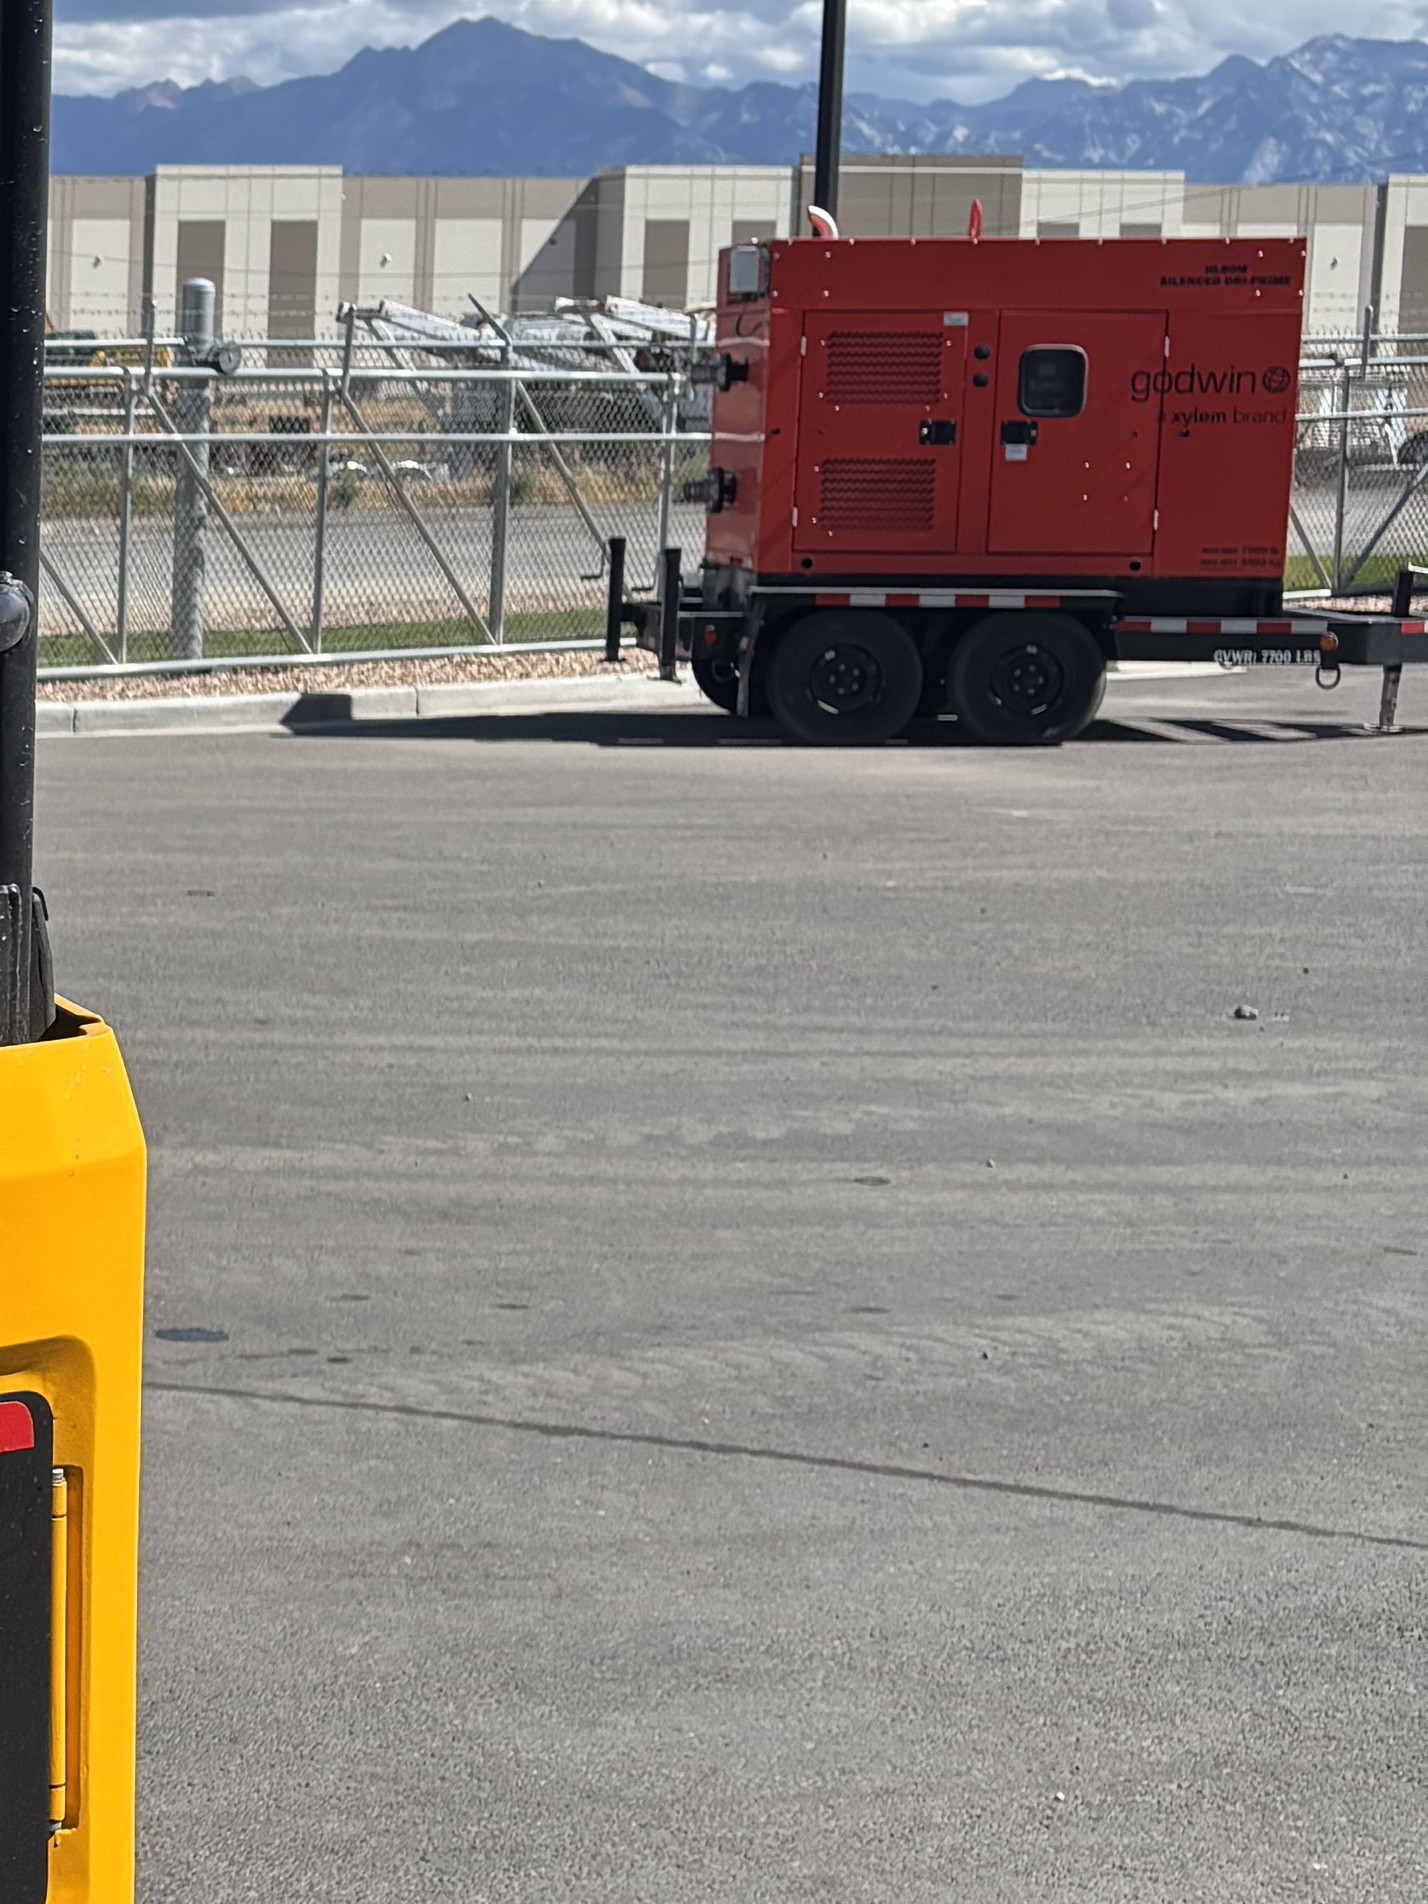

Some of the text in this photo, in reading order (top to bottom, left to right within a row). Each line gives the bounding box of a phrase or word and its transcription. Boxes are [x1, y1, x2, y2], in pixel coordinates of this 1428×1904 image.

[1130, 364, 1257, 403] godwin
[1171, 407, 1227, 427] xylem
[1232, 406, 1287, 425] brand
